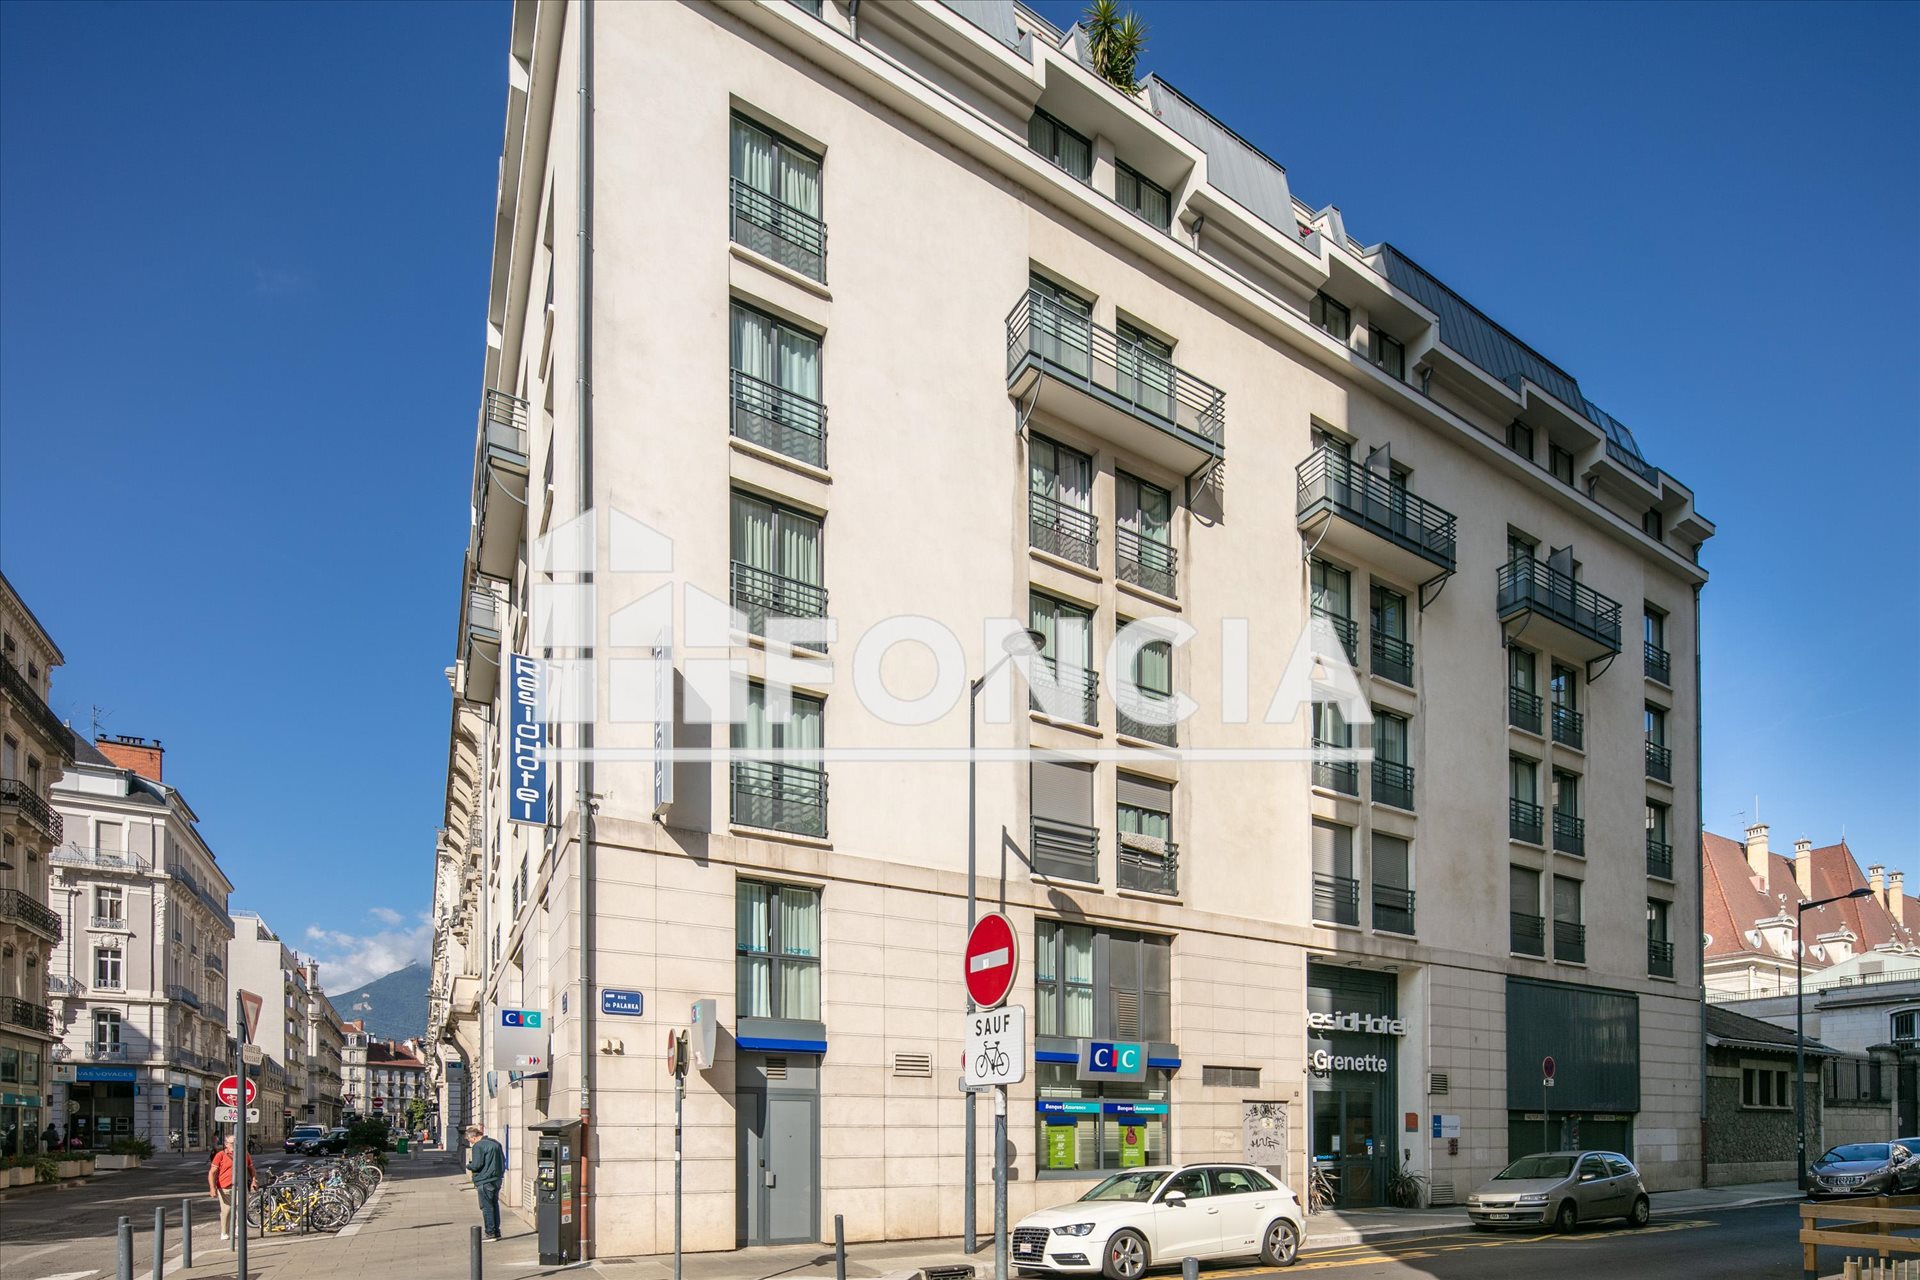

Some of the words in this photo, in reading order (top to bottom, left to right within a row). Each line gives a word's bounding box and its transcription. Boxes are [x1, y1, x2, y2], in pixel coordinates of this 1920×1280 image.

[504, 1012, 538, 1026] CIC
[975, 1013, 1010, 1036] SAUF
[1307, 1010, 1407, 1036] esidHotel
[1093, 1047, 1137, 1069] CIC
[1313, 1049, 1387, 1073] Grenette
[562, 1146, 569, 1158] P
